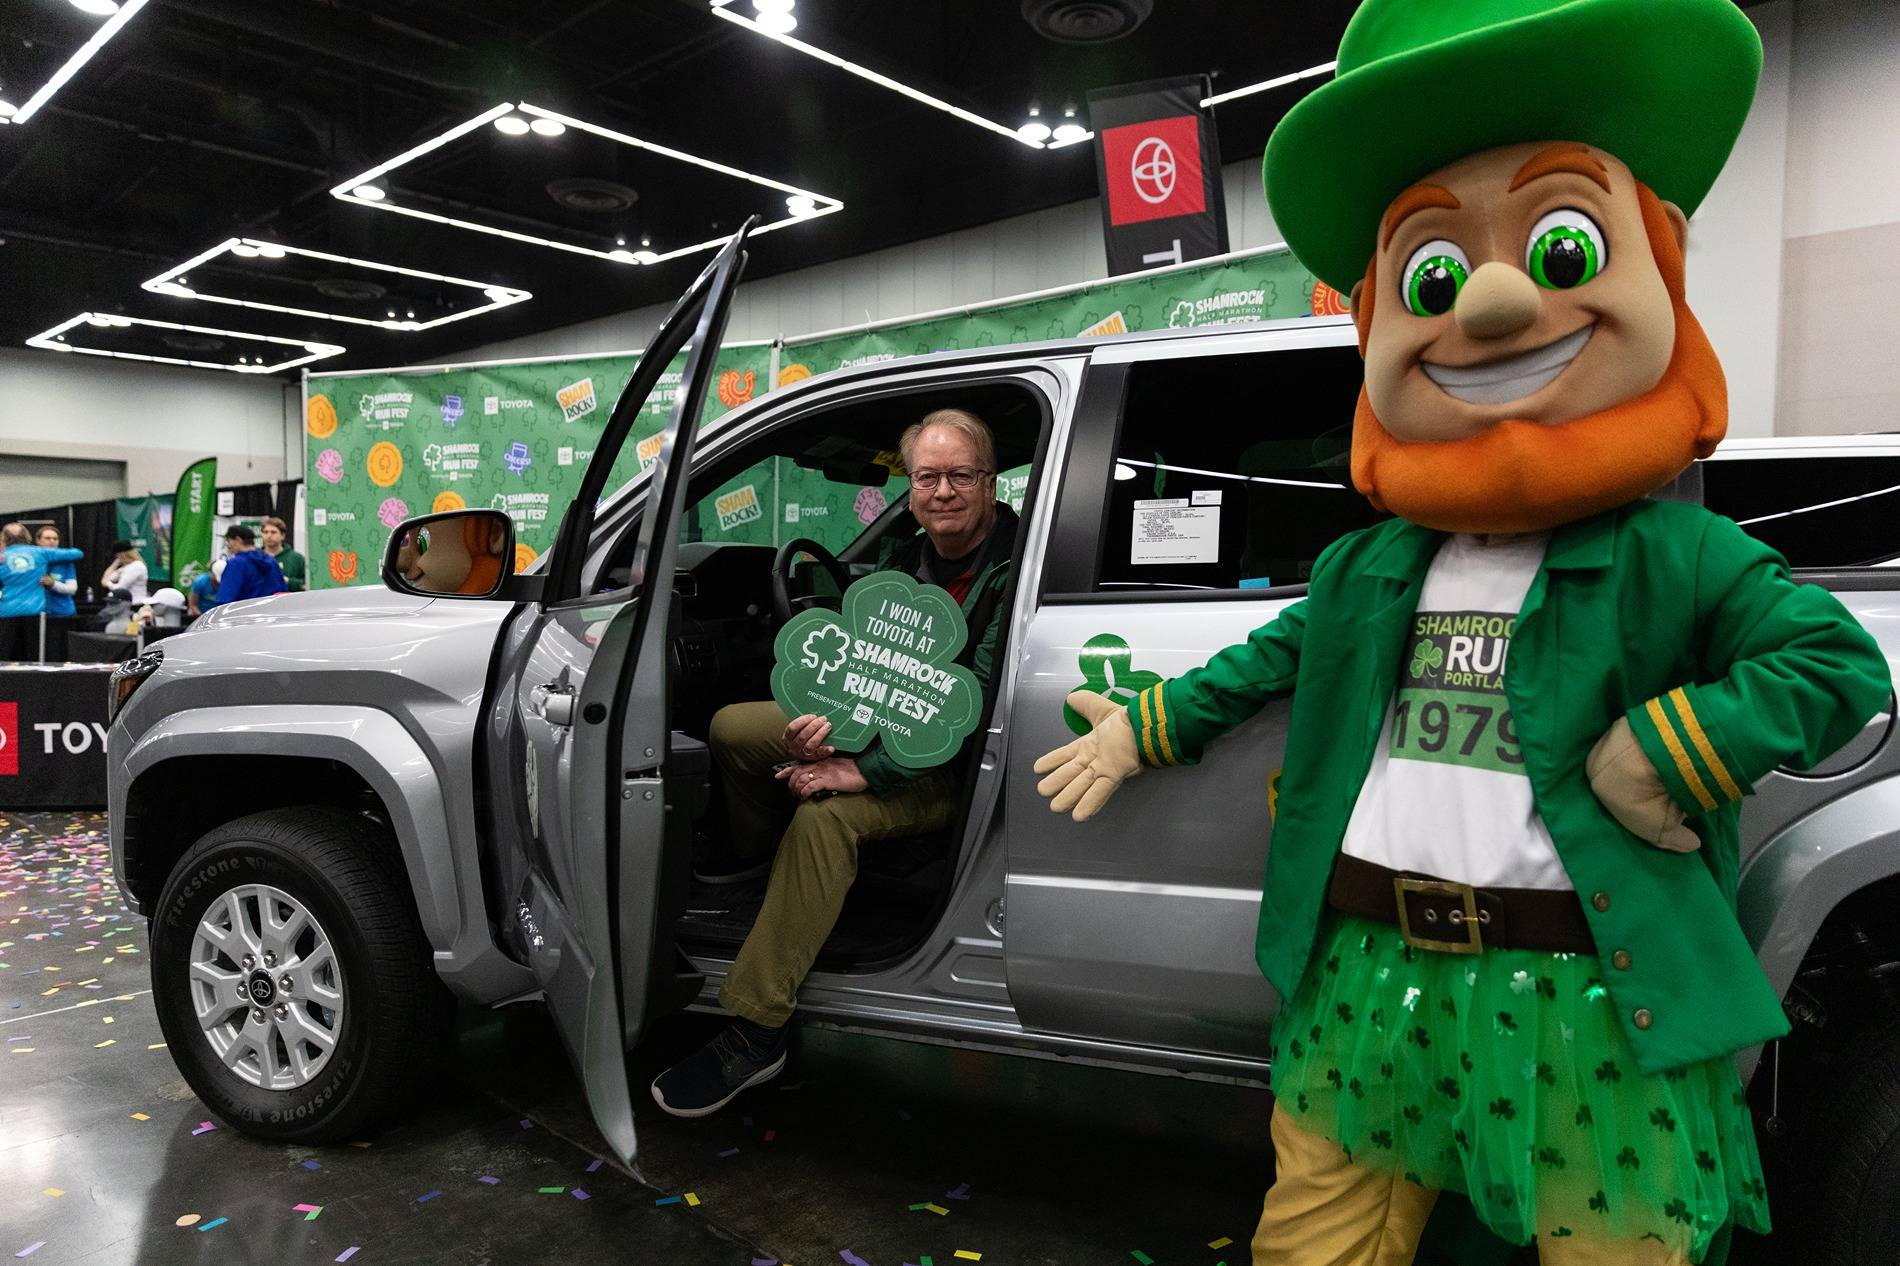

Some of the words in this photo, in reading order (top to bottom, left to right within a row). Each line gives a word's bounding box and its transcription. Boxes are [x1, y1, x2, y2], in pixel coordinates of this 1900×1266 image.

[1196, 290, 1264, 314] SHAMROCK
[1219, 308, 1262, 316] MARATHON
[500, 400, 533, 409] TOYOTA
[559, 382, 591, 408] SHAM
[566, 396, 594, 418] ROCK!
[190, 471, 202, 513] START
[717, 489, 754, 515] SHAM
[327, 512, 355, 521] TOYOTA
[722, 504, 758, 527] ROCK!
[801, 506, 828, 517] TOYOTA
[879, 599, 888, 616] I
[890, 602, 922, 628] WON
[922, 616, 933, 633] A
[866, 616, 914, 648] TOYOTA
[916, 636, 936, 655] AT
[852, 639, 958, 695] SHAMROCK
[848, 661, 878, 675] HALF
[883, 672, 946, 706] MARATHON
[807, 690, 844, 710] PRESENTED
[842, 703, 853, 712] BY
[843, 671, 888, 704] RUN
[888, 688, 940, 725] FEST
[874, 715, 912, 737] TOYOTA
